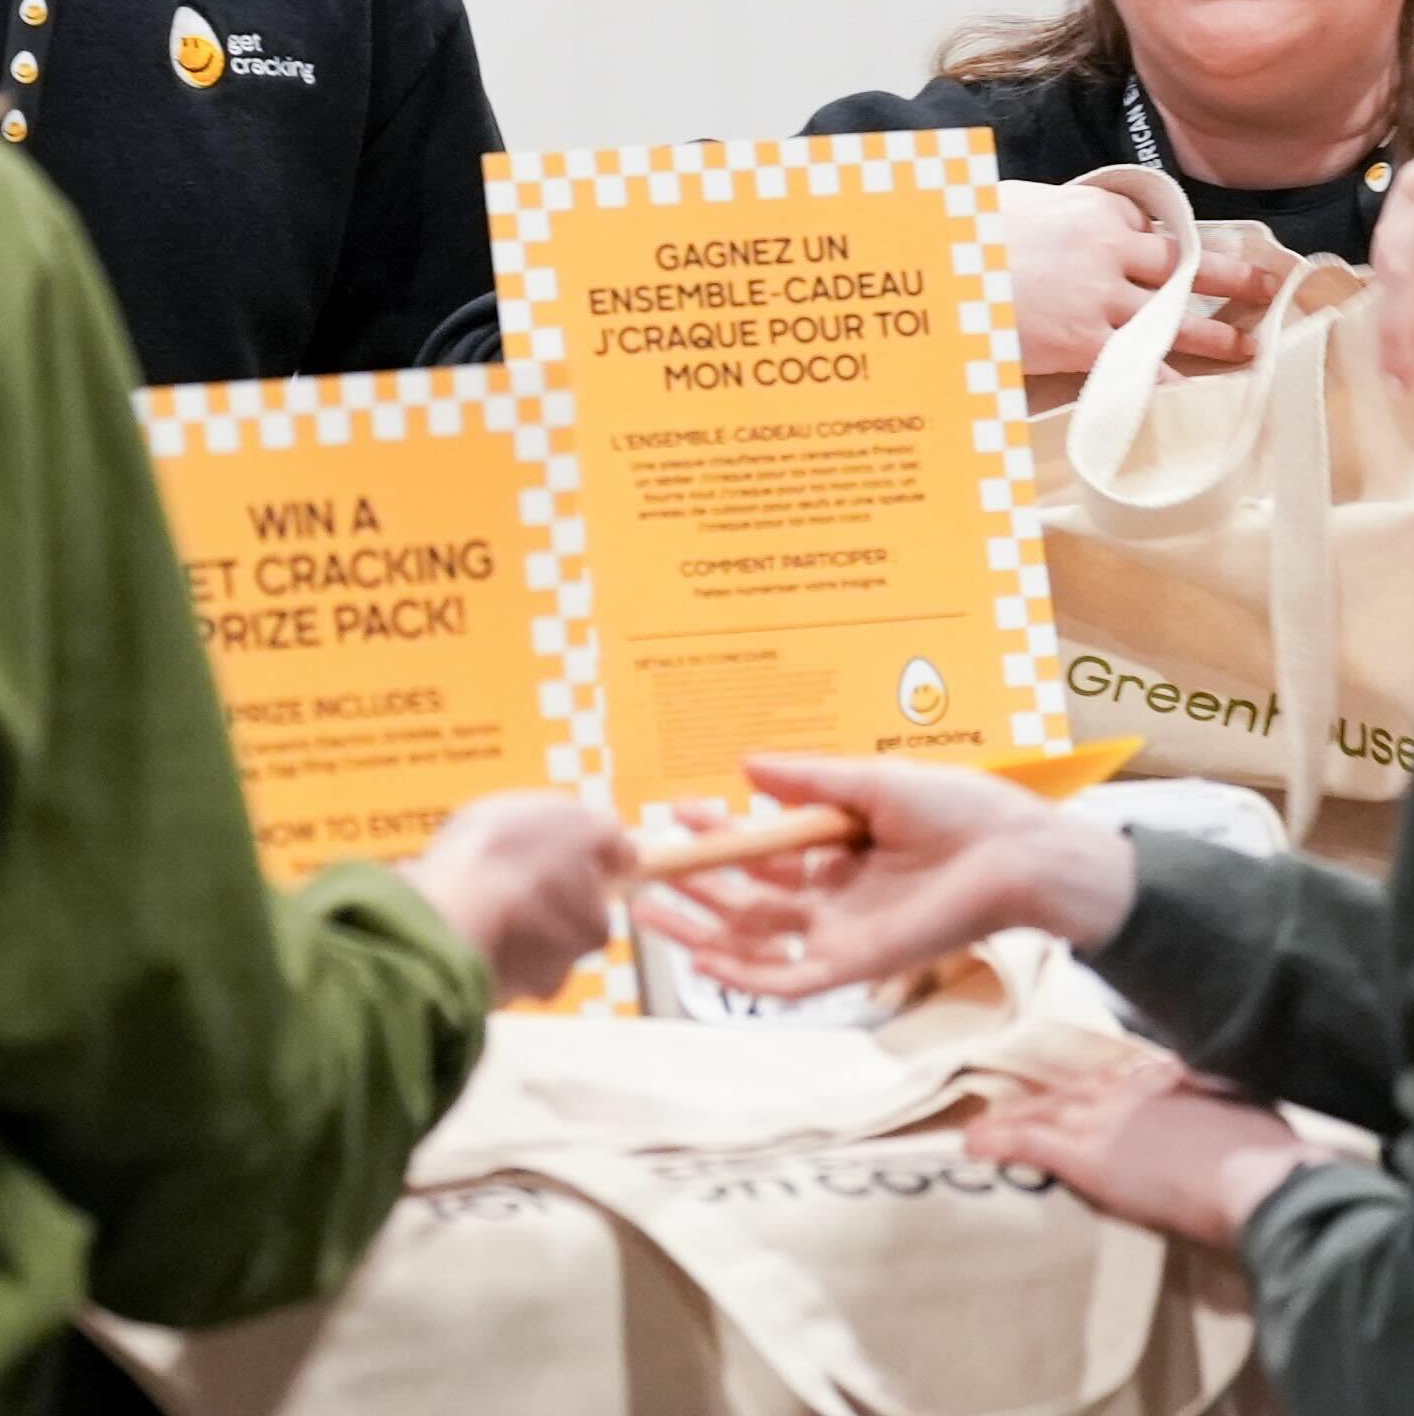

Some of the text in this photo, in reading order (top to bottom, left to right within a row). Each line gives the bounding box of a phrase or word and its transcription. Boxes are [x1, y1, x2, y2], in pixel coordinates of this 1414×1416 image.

[227, 33, 263, 55] get
[230, 56, 316, 84] cracking
[655, 235, 850, 271] GAGNEZ UN
[588, 269, 924, 316] ENSEMBLE-CADEAU
[594, 309, 930, 356] J'CRAQUE POUR TOI
[664, 353, 869, 392] MON COCO!
[247, 495, 380, 541] WIN A
[254, 538, 494, 597] CRACKING
[679, 555, 775, 579] COMMENT
[334, 595, 467, 642] PACK!
